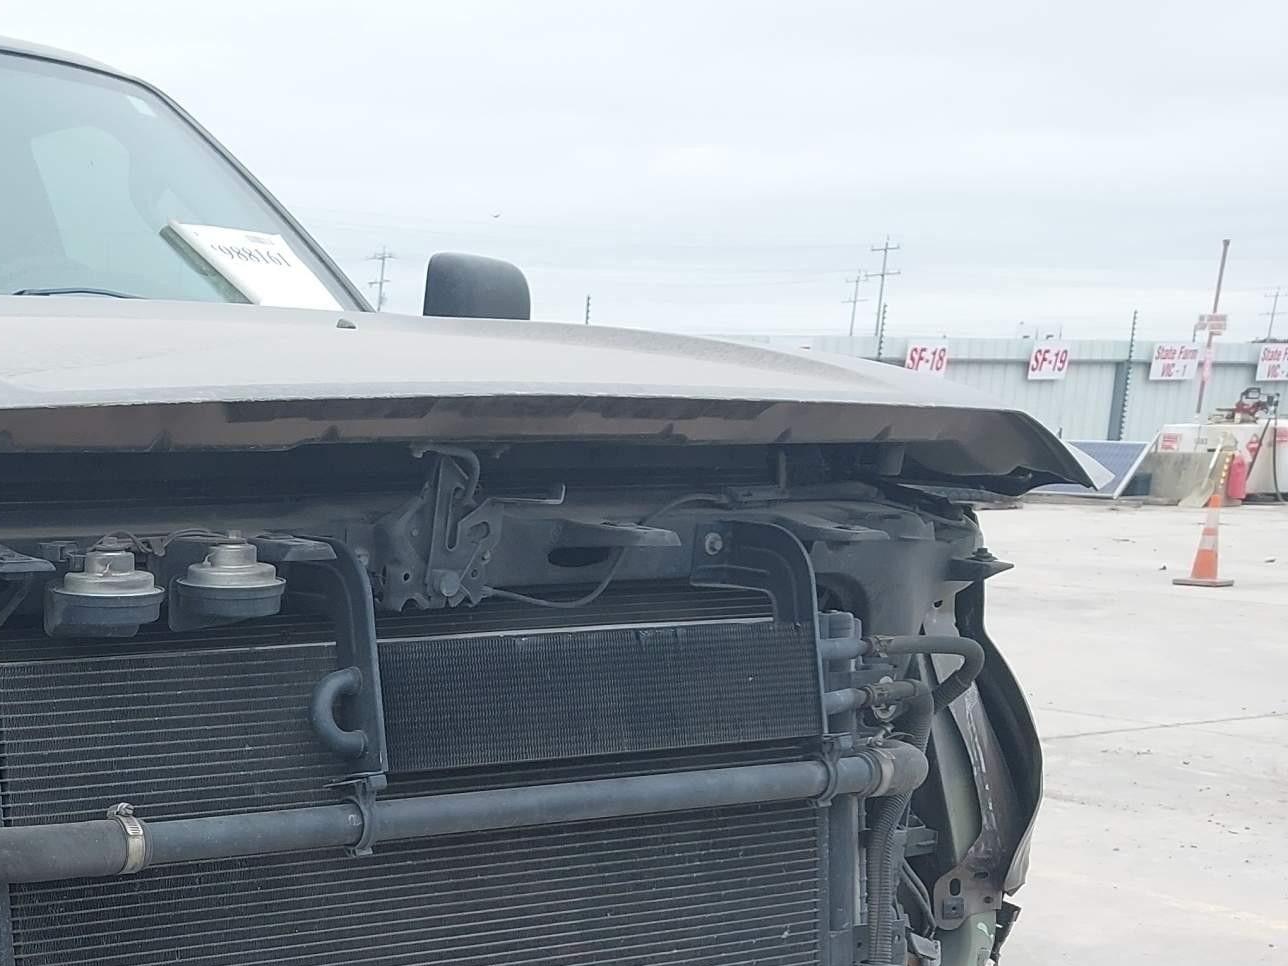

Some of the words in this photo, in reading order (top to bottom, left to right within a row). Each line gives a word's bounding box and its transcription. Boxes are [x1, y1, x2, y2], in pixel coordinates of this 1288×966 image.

[906, 347, 947, 371] SF-18
[1031, 349, 1069, 372] SF-19
[1155, 345, 1177, 360] State
[1178, 345, 1199, 360] Farm
[1261, 347, 1282, 361] State
